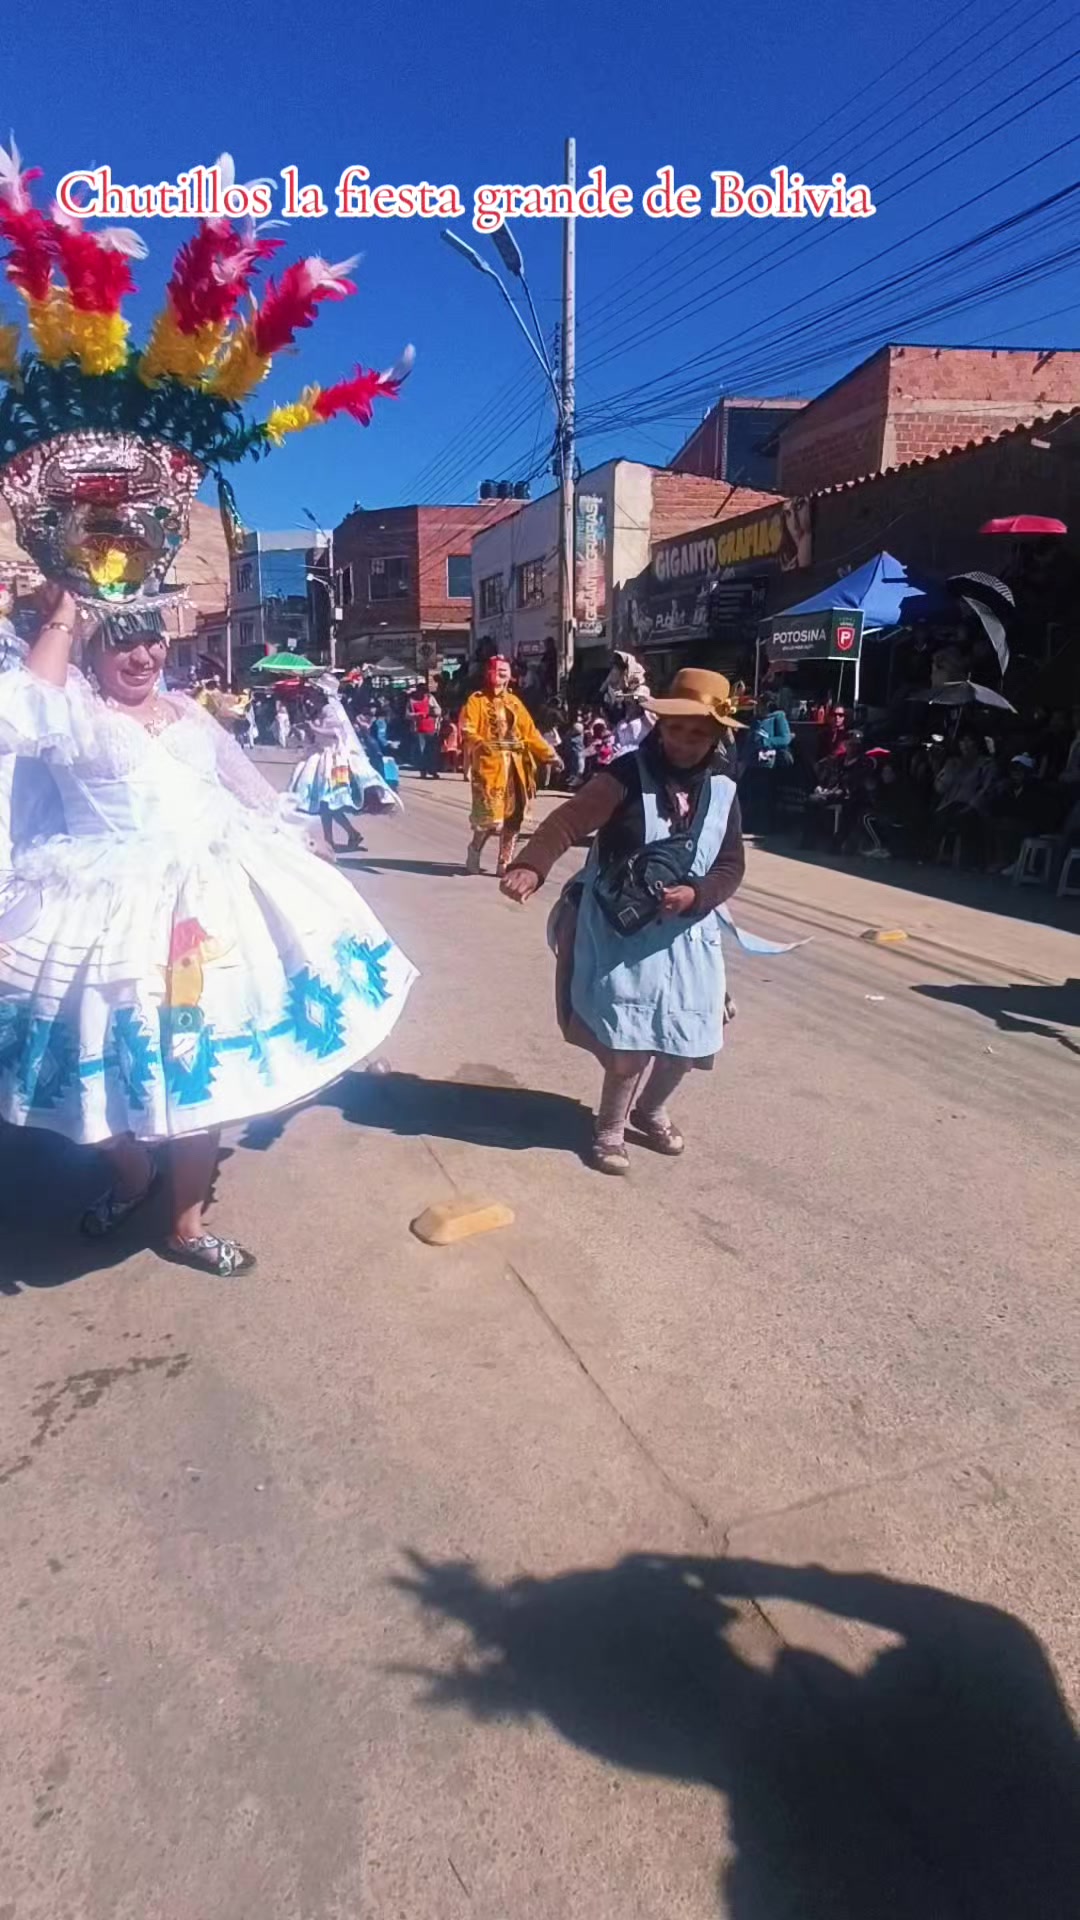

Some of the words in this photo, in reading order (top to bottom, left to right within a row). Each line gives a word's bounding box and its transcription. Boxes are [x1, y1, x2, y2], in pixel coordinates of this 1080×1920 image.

[655, 537, 717, 581] GIGANTO
[772, 628, 826, 644] POTOSINA
[841, 631, 851, 645] P
